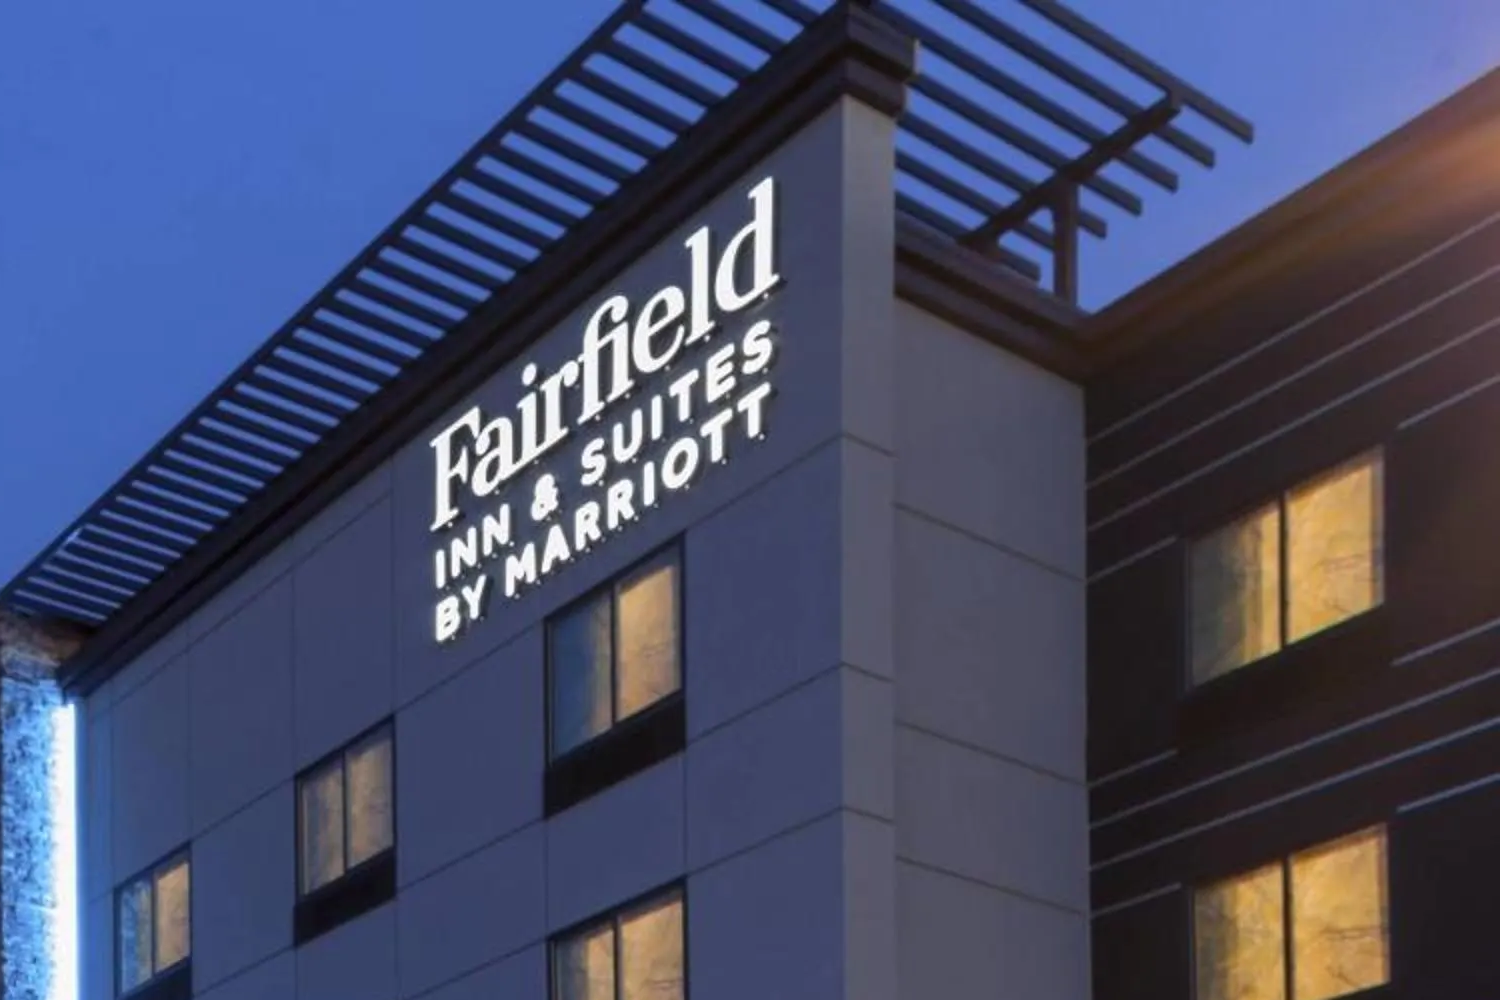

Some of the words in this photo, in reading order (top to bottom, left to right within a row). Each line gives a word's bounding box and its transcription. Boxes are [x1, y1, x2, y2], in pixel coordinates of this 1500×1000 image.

[430, 176, 780, 532] Fairfield
[435, 503, 511, 590] INN
[530, 473, 559, 522] &
[580, 319, 773, 487] SUITES
[435, 573, 487, 642] BY
[505, 382, 771, 598] MARRIOTT
